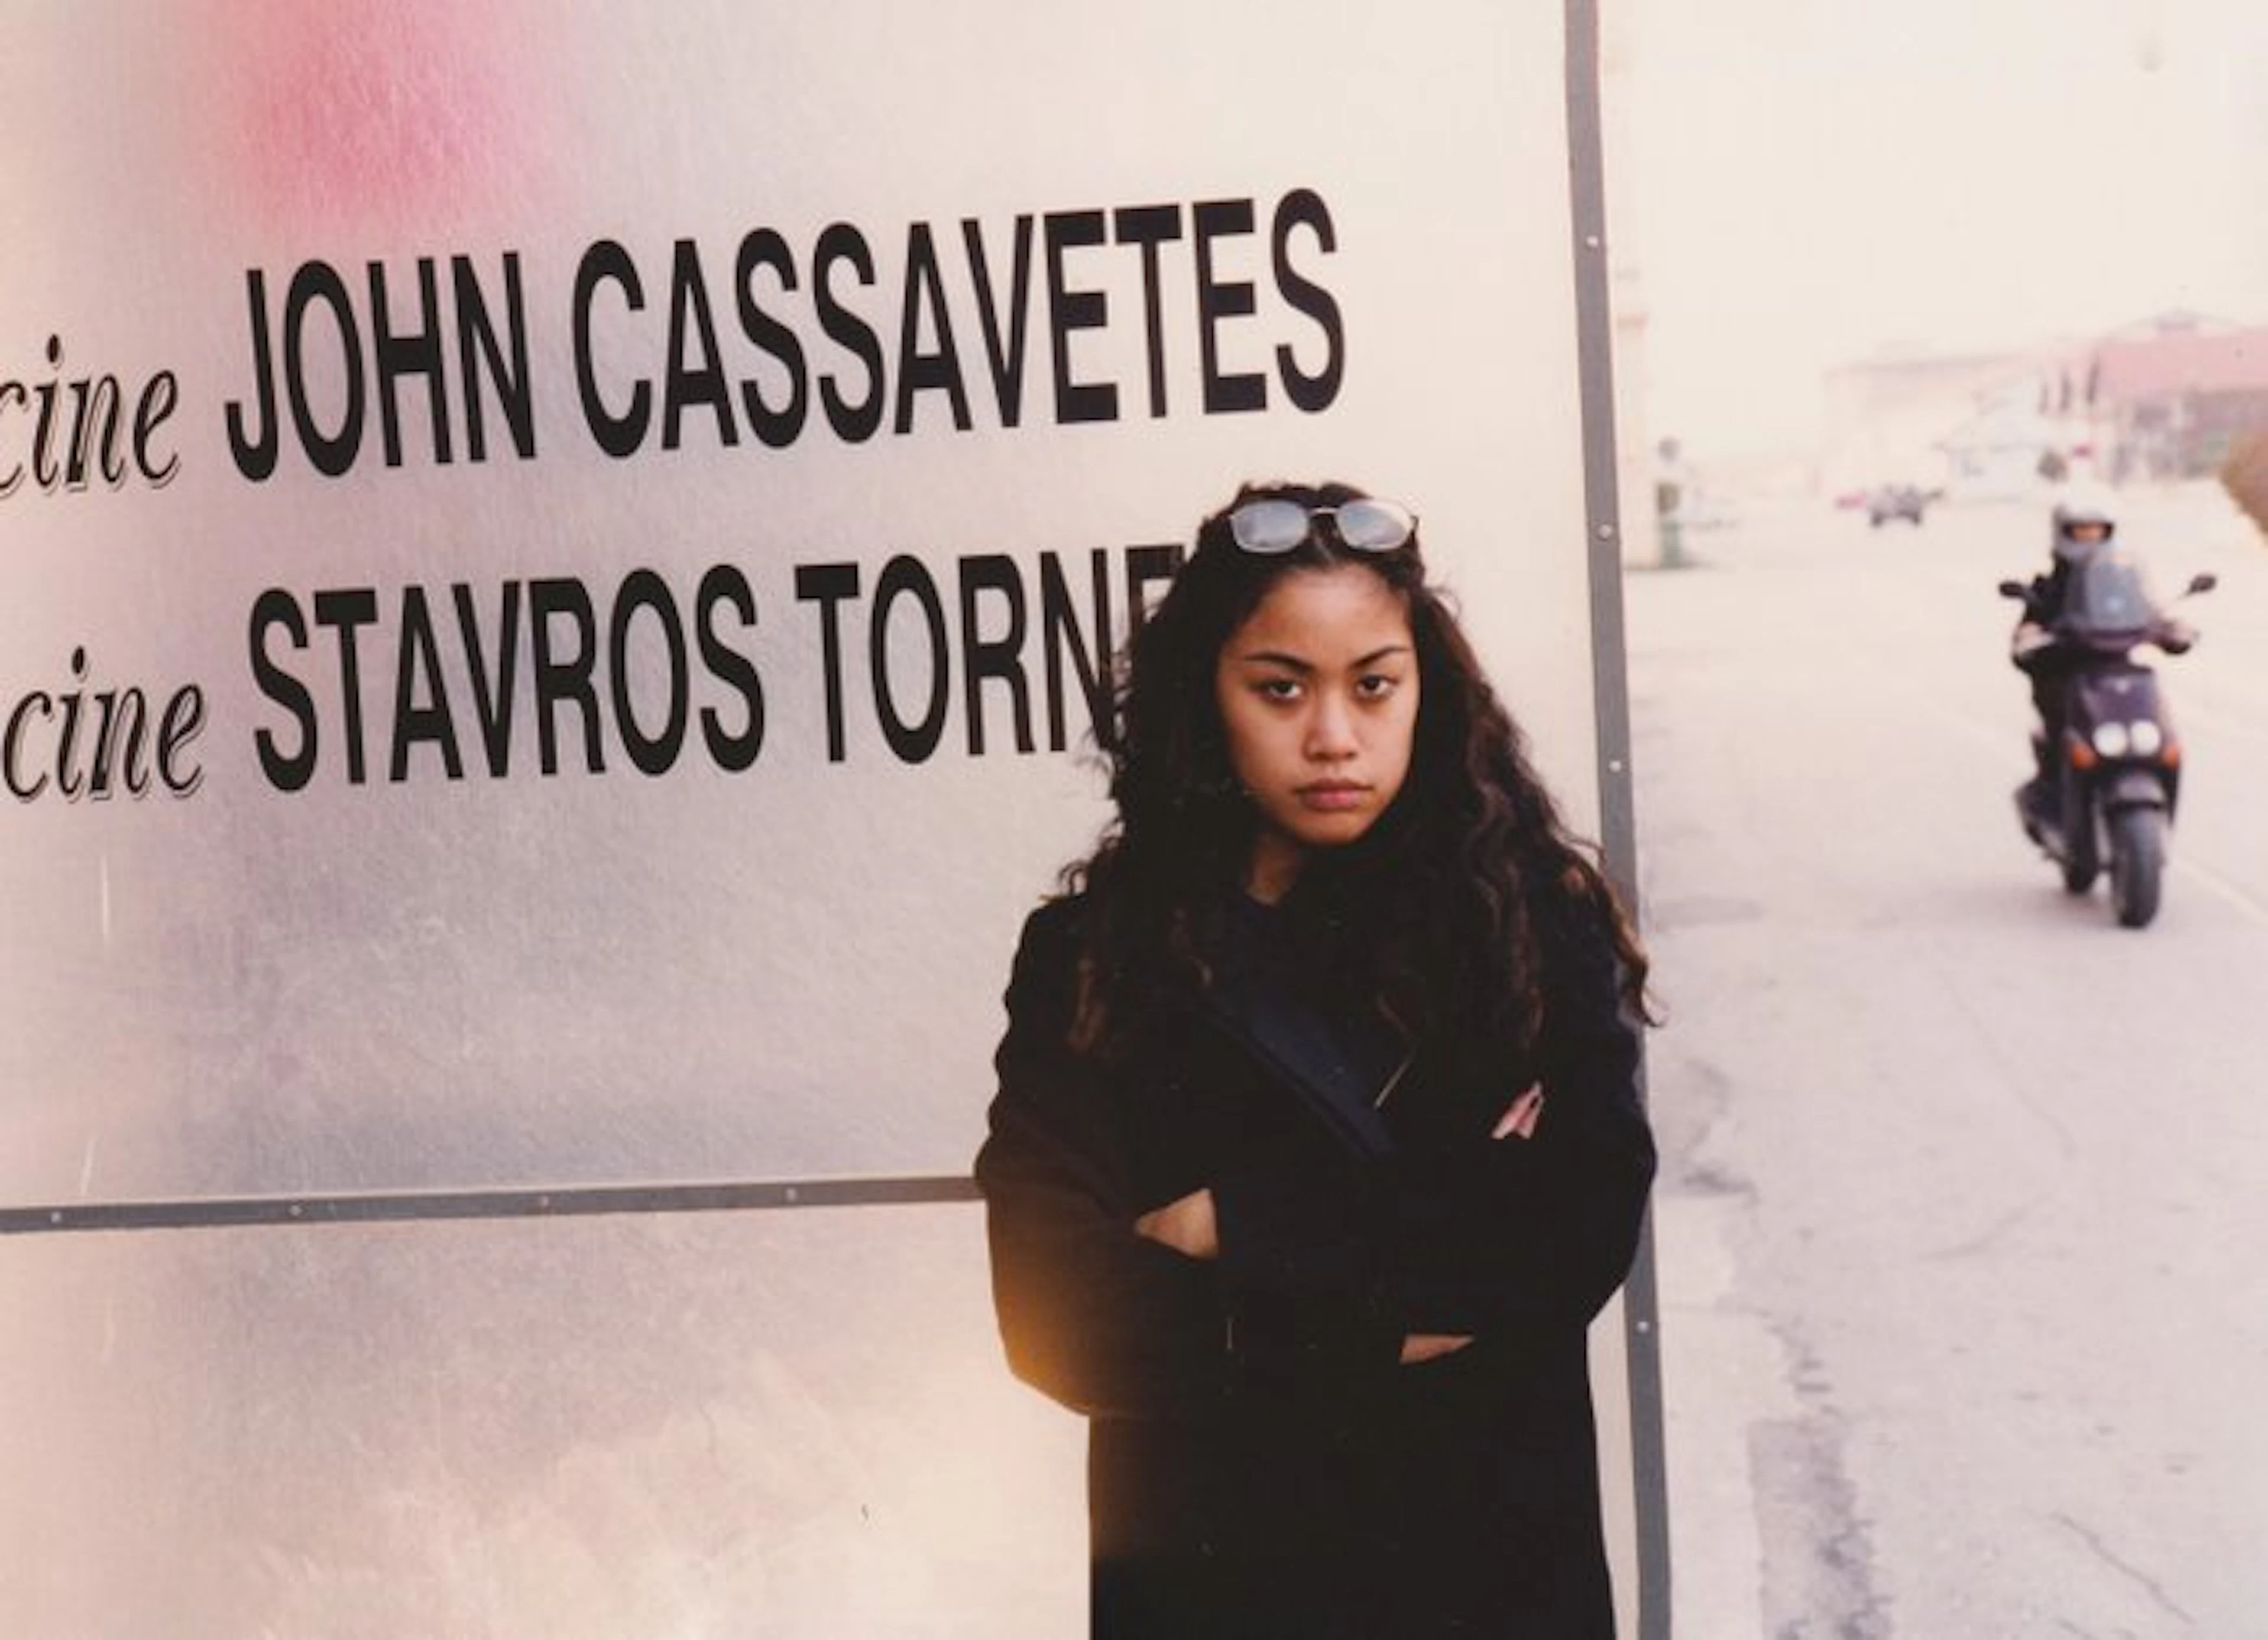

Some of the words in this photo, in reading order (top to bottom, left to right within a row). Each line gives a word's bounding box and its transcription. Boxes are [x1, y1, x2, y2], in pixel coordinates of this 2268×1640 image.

[224, 251, 537, 483] JOHN
[572, 188, 1344, 460] CASSAVETES
[2, 646, 205, 802] cine
[248, 564, 765, 793] STAVROS
